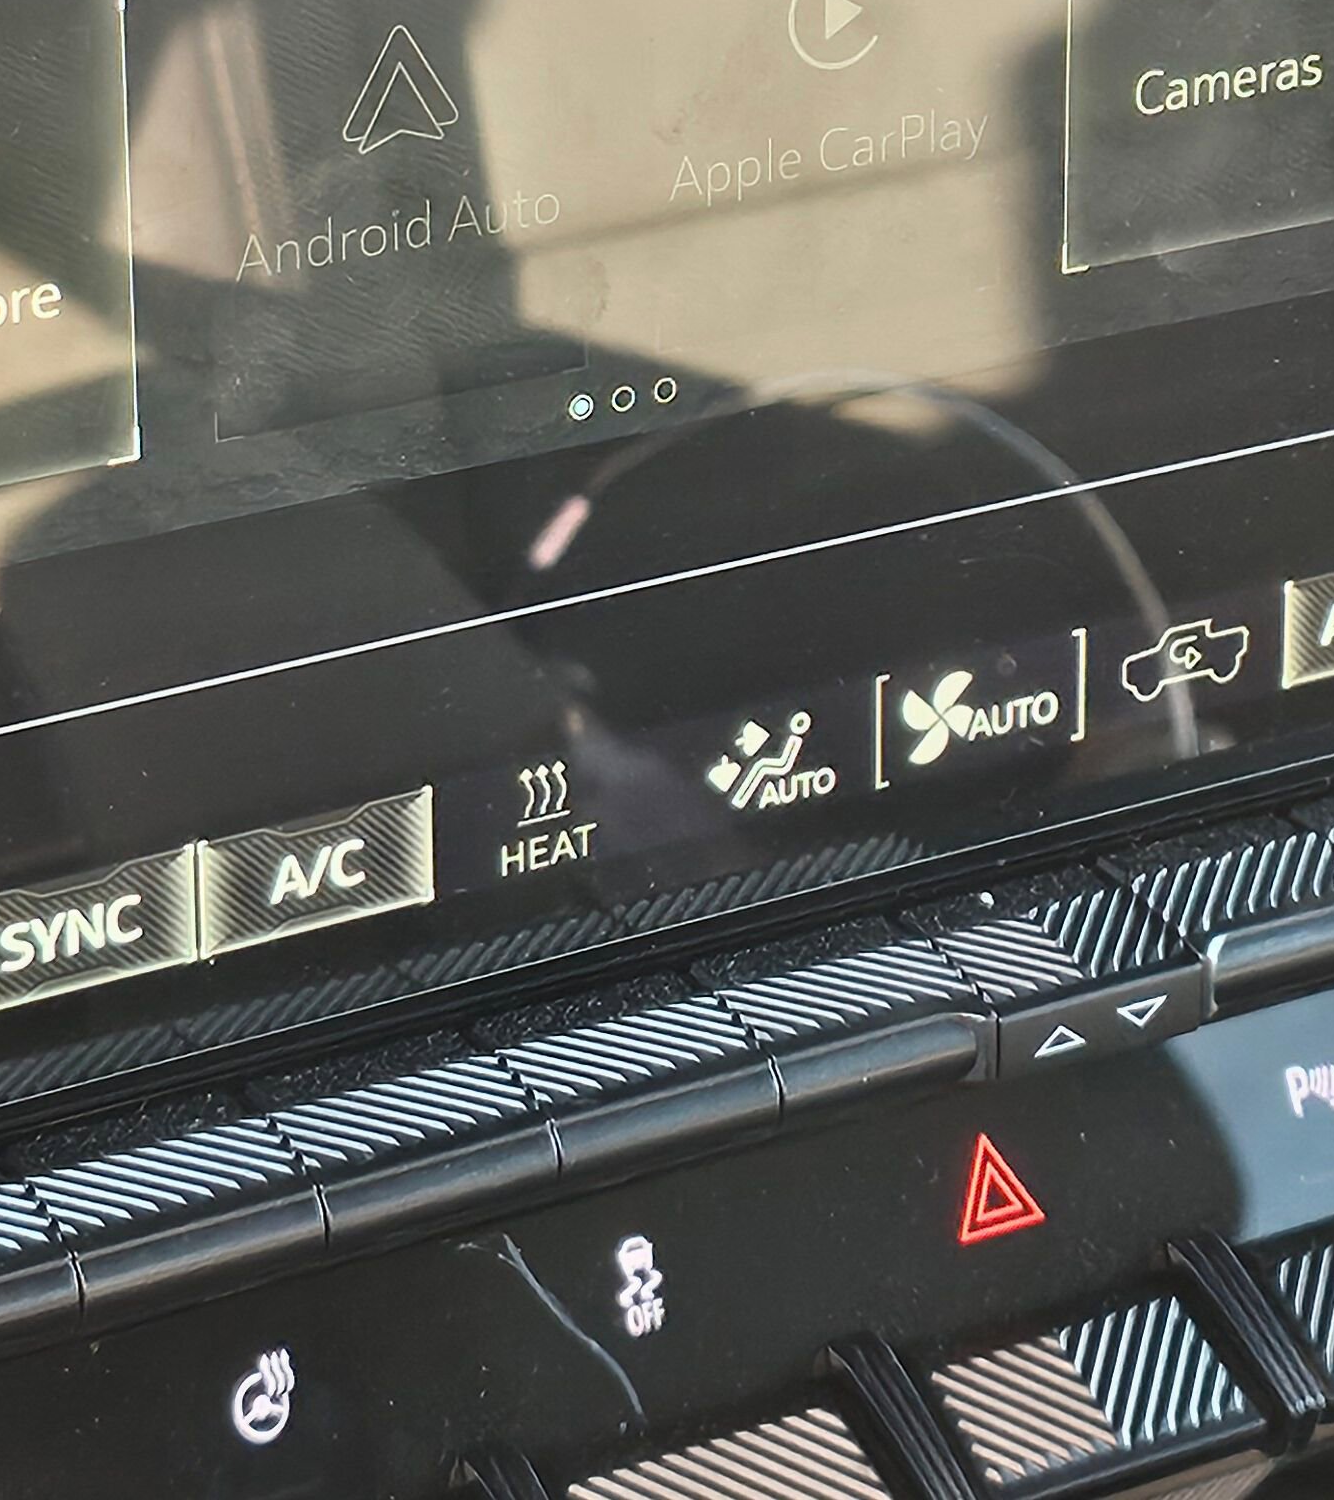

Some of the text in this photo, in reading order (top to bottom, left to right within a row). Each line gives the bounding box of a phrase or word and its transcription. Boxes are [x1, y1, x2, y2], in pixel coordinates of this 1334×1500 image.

[1133, 50, 1324, 119] Cameras
[668, 113, 990, 206] Apple CarPlay
[235, 190, 561, 283] Android Auto
[967, 690, 1060, 743] AUTO
[758, 764, 837, 811] AUTO
[268, 837, 366, 906] A/C
[500, 822, 598, 878] HEAT
[624, 1299, 666, 1339] OFF
